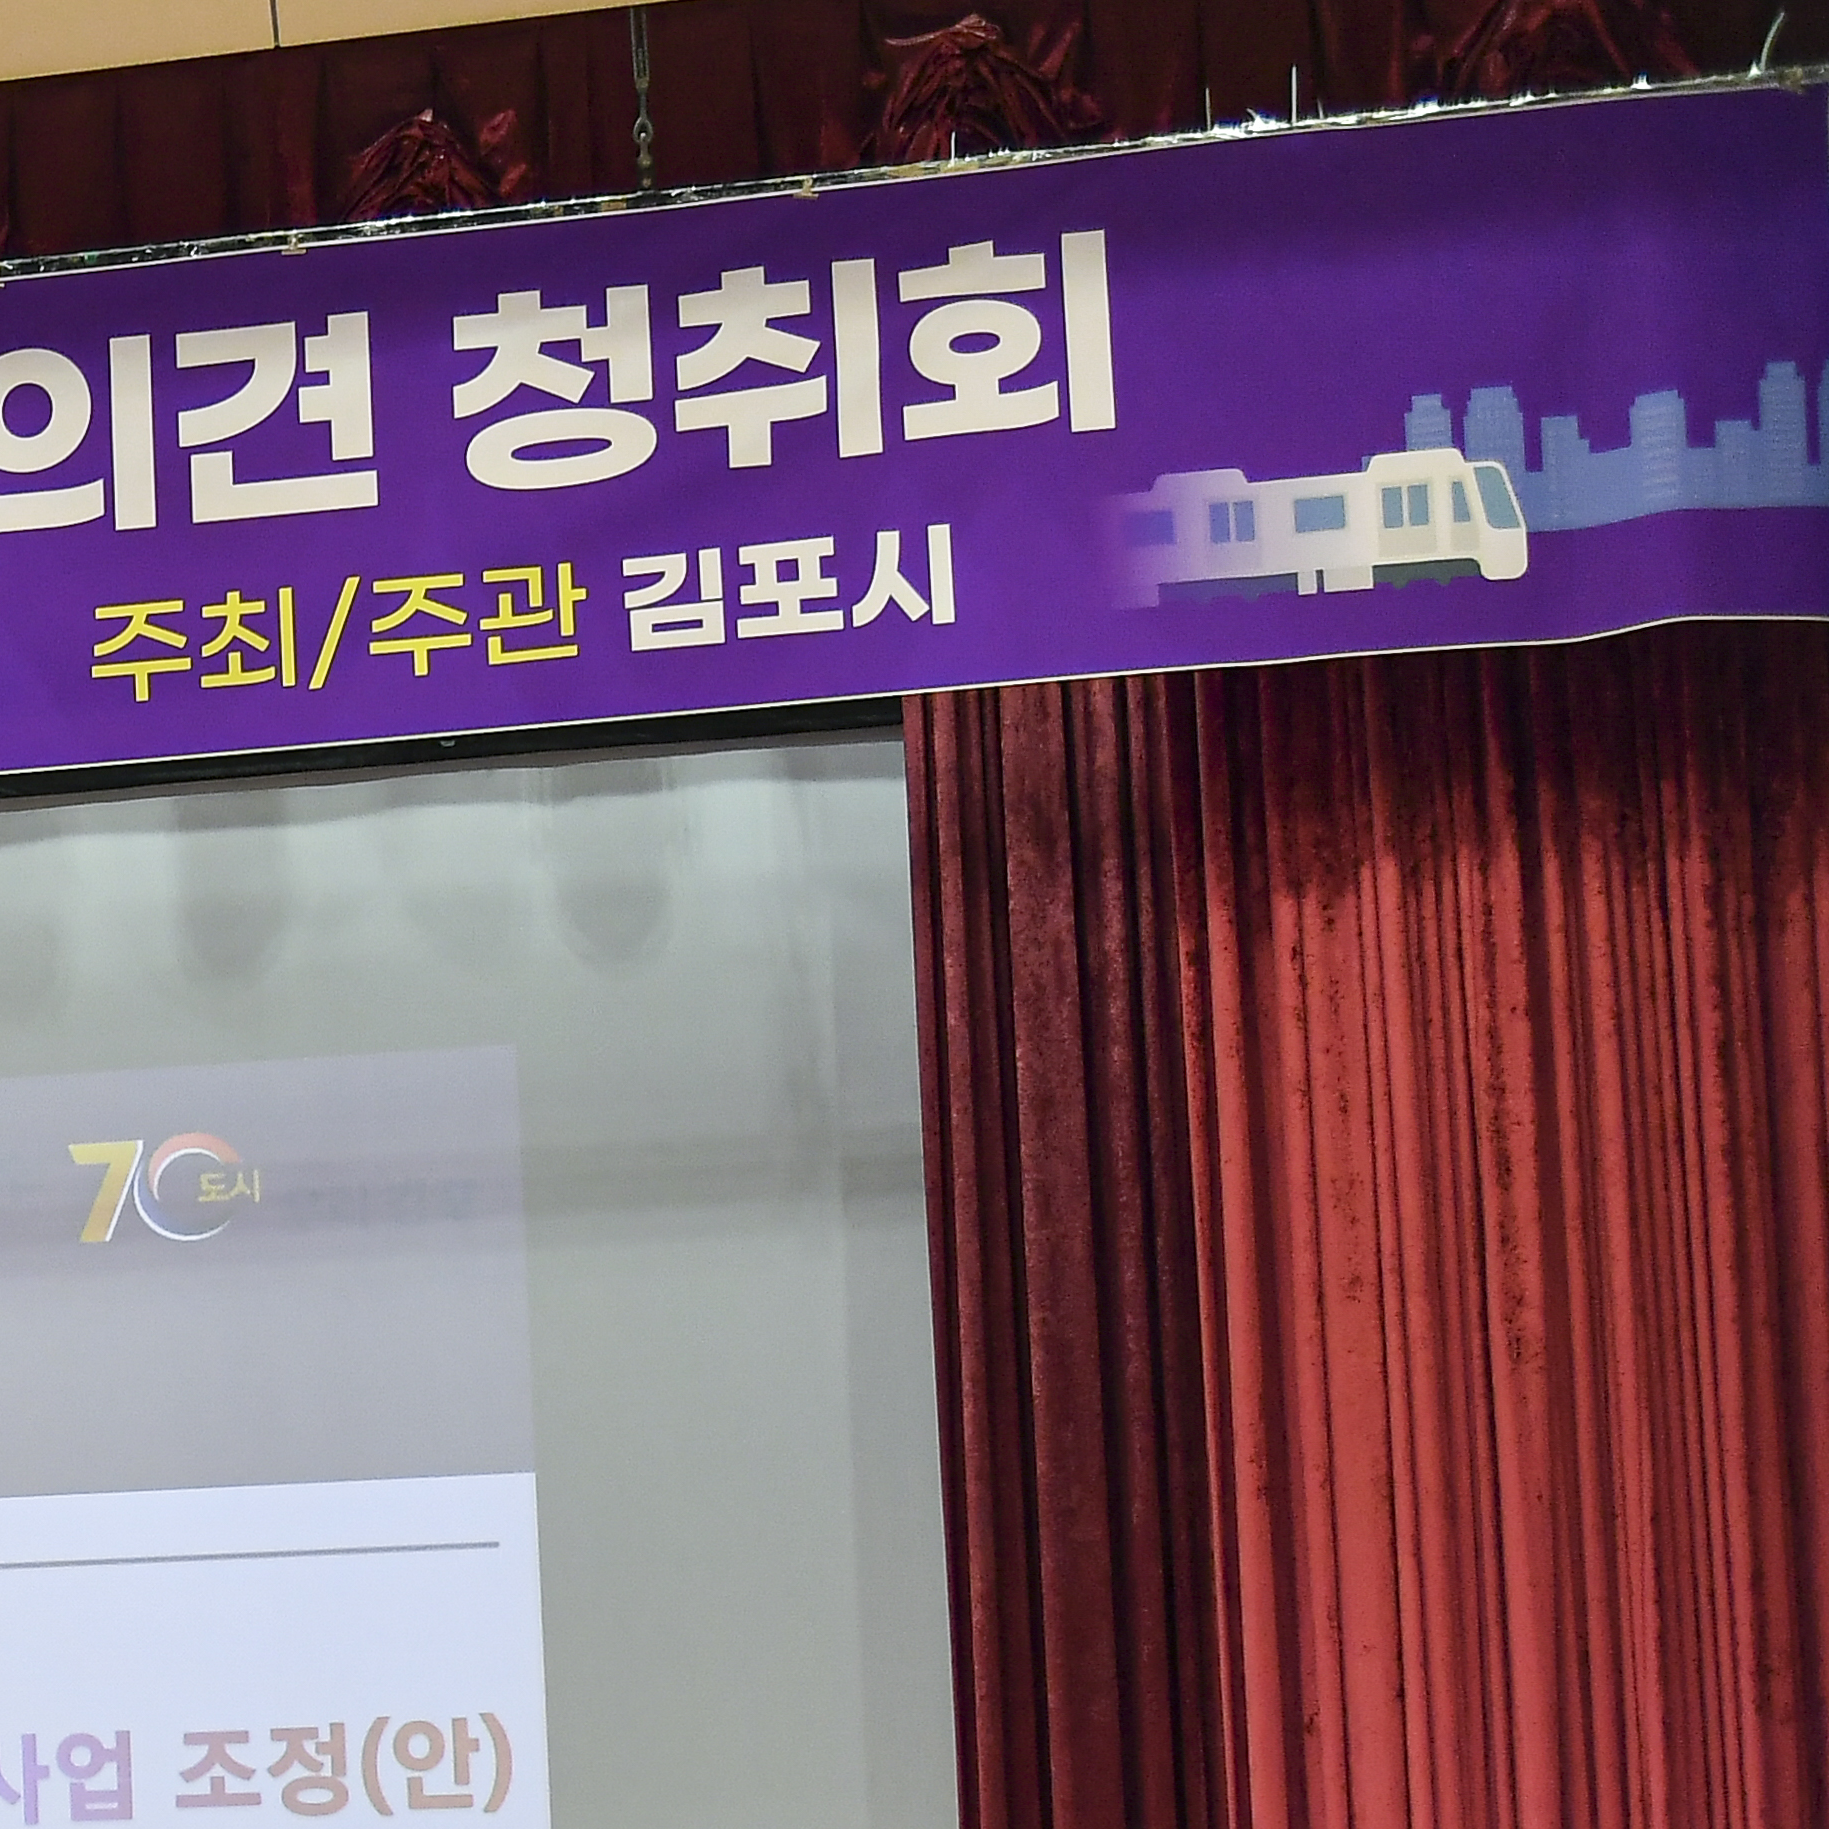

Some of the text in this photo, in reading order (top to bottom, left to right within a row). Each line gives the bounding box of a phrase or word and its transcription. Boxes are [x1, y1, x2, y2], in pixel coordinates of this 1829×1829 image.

[453, 230, 1118, 492] 청취회
[89, 523, 956, 703] 주최/주관 김포시
[198, 1169, 261, 1203] 도시
[173, 1709, 515, 1817] 조정(안)
